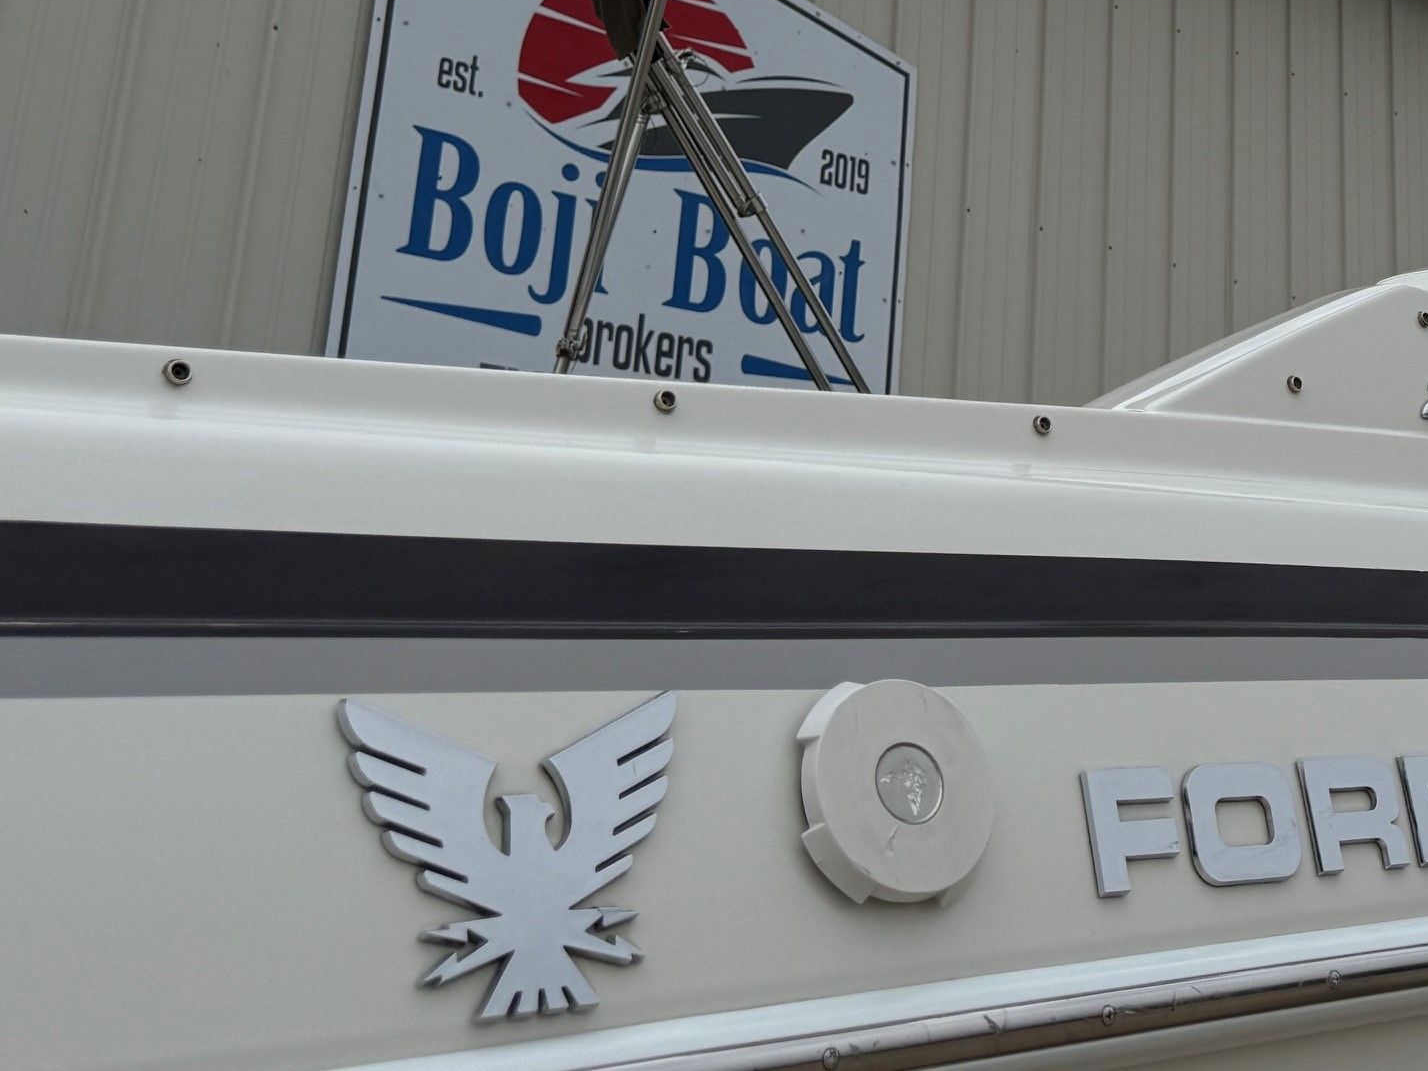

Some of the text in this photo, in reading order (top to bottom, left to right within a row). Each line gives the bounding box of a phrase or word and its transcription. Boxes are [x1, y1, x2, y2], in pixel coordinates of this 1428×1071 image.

[437, 55, 484, 98] est.
[820, 148, 870, 195] 2019
[661, 188, 866, 343] Boat
